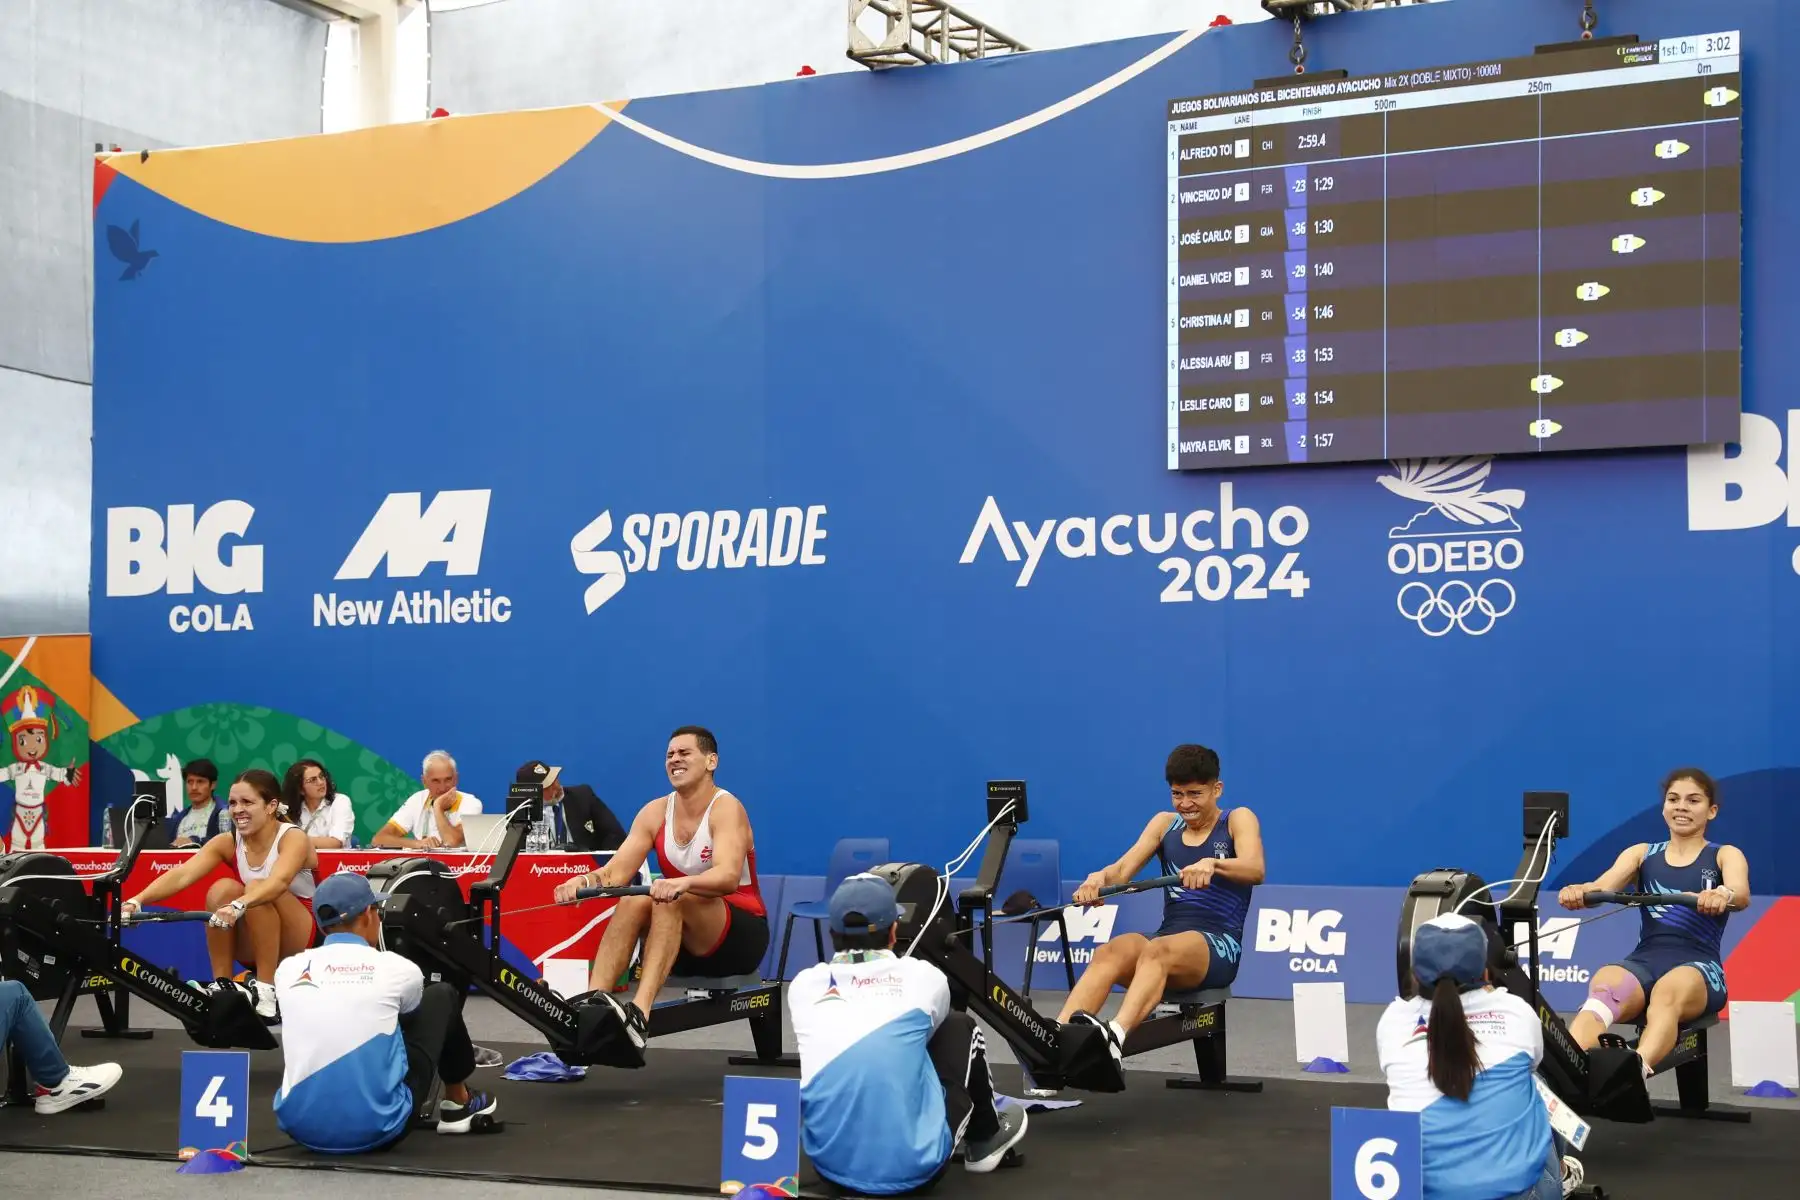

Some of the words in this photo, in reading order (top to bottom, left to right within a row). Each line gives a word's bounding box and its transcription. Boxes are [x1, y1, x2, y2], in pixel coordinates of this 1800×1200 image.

[1706, 36, 1730, 52] 3:02
[1698, 63, 1712, 74] 0m
[1172, 100, 1202, 114] JUEGOS
[1203, 92, 1260, 110] BOLIVARIANOS
[1260, 91, 1276, 102] DEL
[1278, 83, 1335, 100] BICENTENARIO
[1336, 78, 1381, 94] AYACUCHO
[1384, 77, 1396, 88] Mix
[1398, 75, 1409, 86] 2X
[1410, 70, 1440, 88] (DOBLE
[1443, 67, 1472, 81] MIXTO)
[1528, 80, 1552, 94] 250m
[1302, 107, 1322, 116] FINISH
[1374, 98, 1396, 110] 500m
[1180, 122, 1198, 132] NAME
[1234, 114, 1250, 124] LANE
[1180, 146, 1218, 160] ALFREDO
[1298, 134, 1326, 149] 2:59.4
[1180, 188, 1220, 204] VINCENZO
[1292, 180, 1306, 192] -23
[1314, 177, 1334, 192] 1:29
[1180, 229, 1201, 246] JOSÉ
[1292, 222, 1306, 235] -36
[1314, 220, 1334, 234] 1:30
[1180, 273, 1209, 287] DANIEL
[1292, 265, 1306, 278] -29
[1314, 263, 1334, 277] 1:40
[1180, 314, 1222, 329] CHRISTINA
[1292, 308, 1306, 320] -54
[1314, 305, 1334, 320] 1:46
[1180, 356, 1214, 370] ALESSIA
[1292, 350, 1306, 363] -33
[1314, 348, 1334, 362] 1:53
[1180, 399, 1207, 412] LESLIE
[1292, 392, 1306, 406] -38
[1314, 390, 1334, 404] 1:54
[1180, 440, 1207, 454] NAYRA
[1298, 434, 1306, 448] -2
[1314, 433, 1334, 447] 1:57
[106, 499, 264, 597] BIG
[622, 504, 827, 573] SPORADE
[958, 481, 1310, 588] Ayacucho
[1388, 538, 1524, 574] ODEBO
[1158, 552, 1311, 603] 2024
[168, 603, 254, 633] COLA
[313, 592, 384, 627] New
[388, 588, 512, 626] Athletic
[1255, 908, 1347, 956] BIG
[1289, 958, 1338, 974] COLA
[140, 970, 195, 1007] concept
[194, 1000, 204, 1012] 2
[516, 982, 564, 1022] concept
[564, 1014, 572, 1027] 2
[1007, 1000, 1047, 1042] concept
[1048, 1033, 1055, 1048] 2
[195, 1076, 233, 1127] 4
[741, 1103, 779, 1161] 5
[1354, 1137, 1400, 1200] 6
